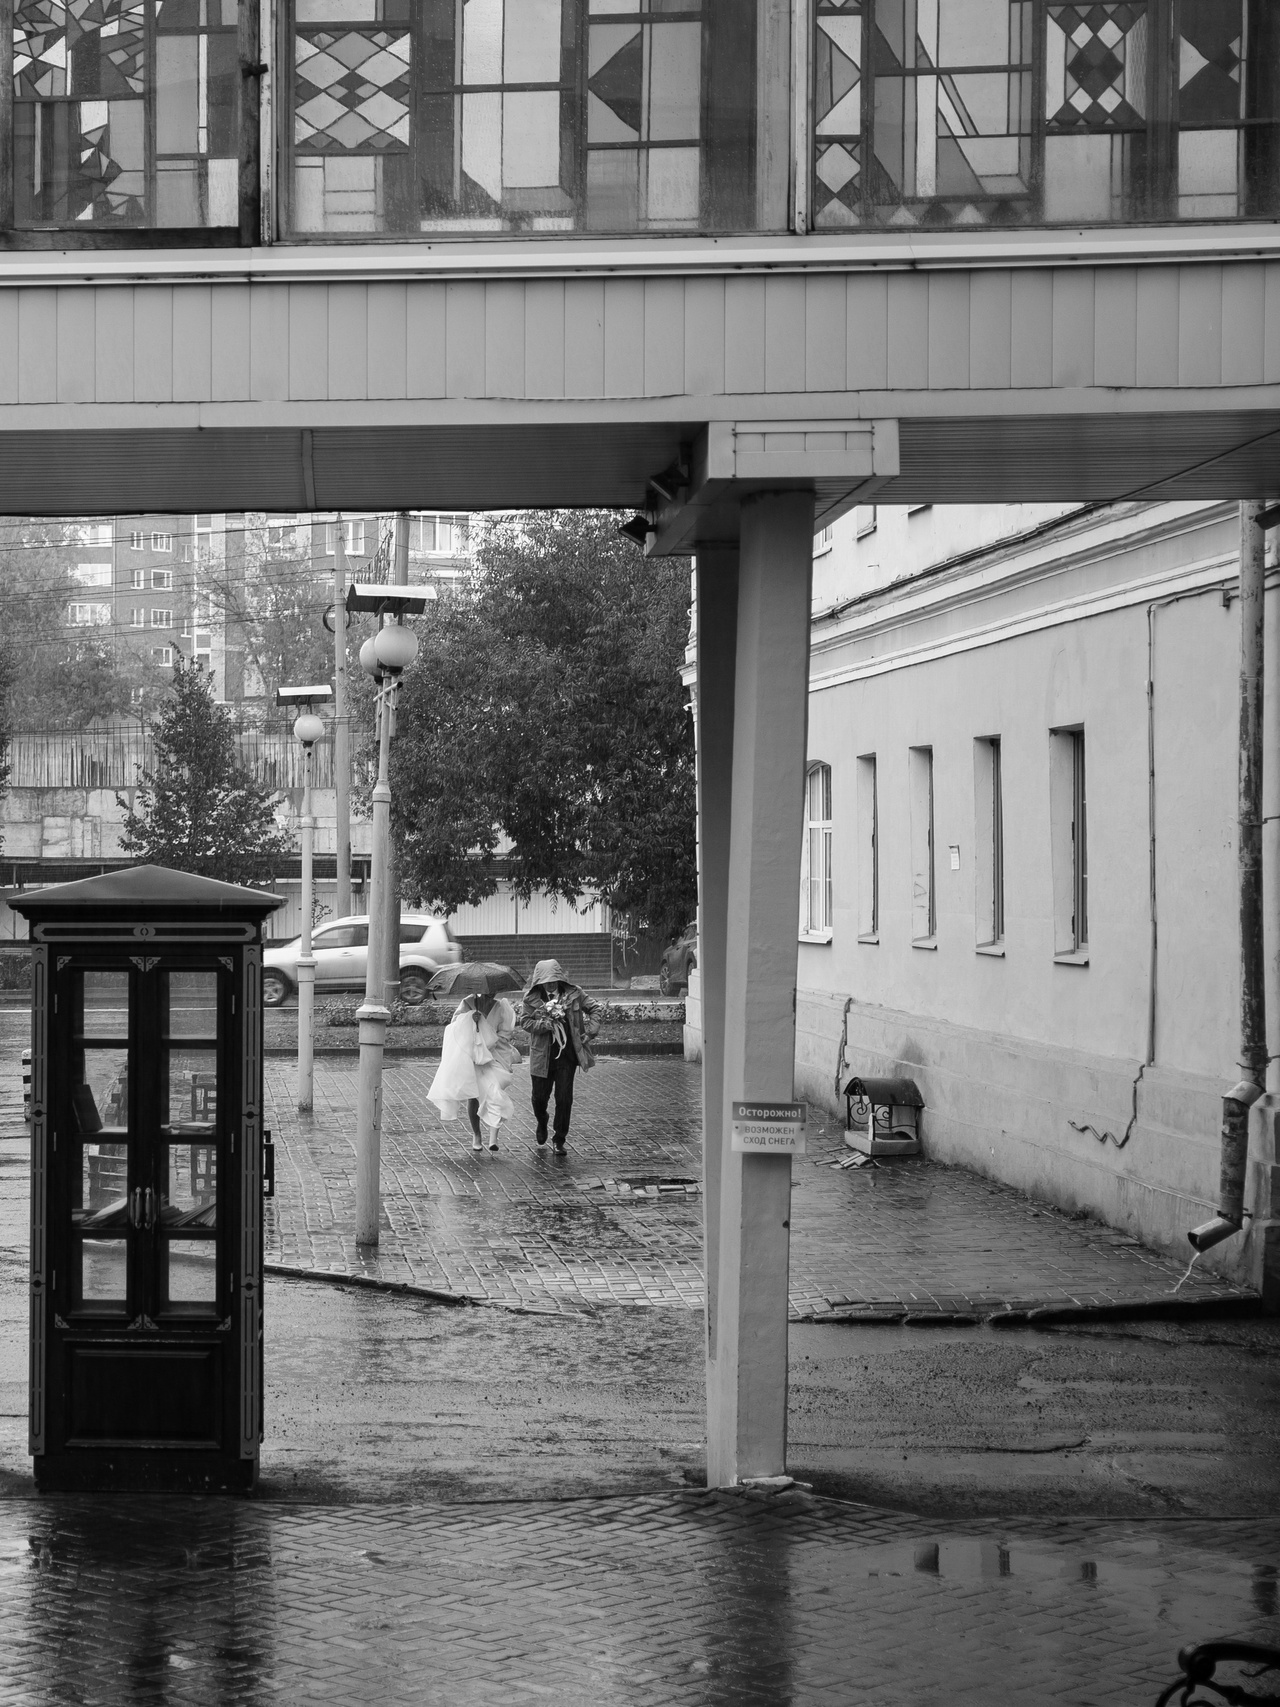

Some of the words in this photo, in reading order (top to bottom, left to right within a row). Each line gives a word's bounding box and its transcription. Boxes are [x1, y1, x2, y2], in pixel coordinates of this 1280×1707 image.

[739, 1107, 802, 1119] Осторожно!
[744, 1126, 795, 1135] ВОЗМОЖЕН
[743, 1136, 766, 1146] СХОД
[768, 1137, 795, 1145] СНЕГА
